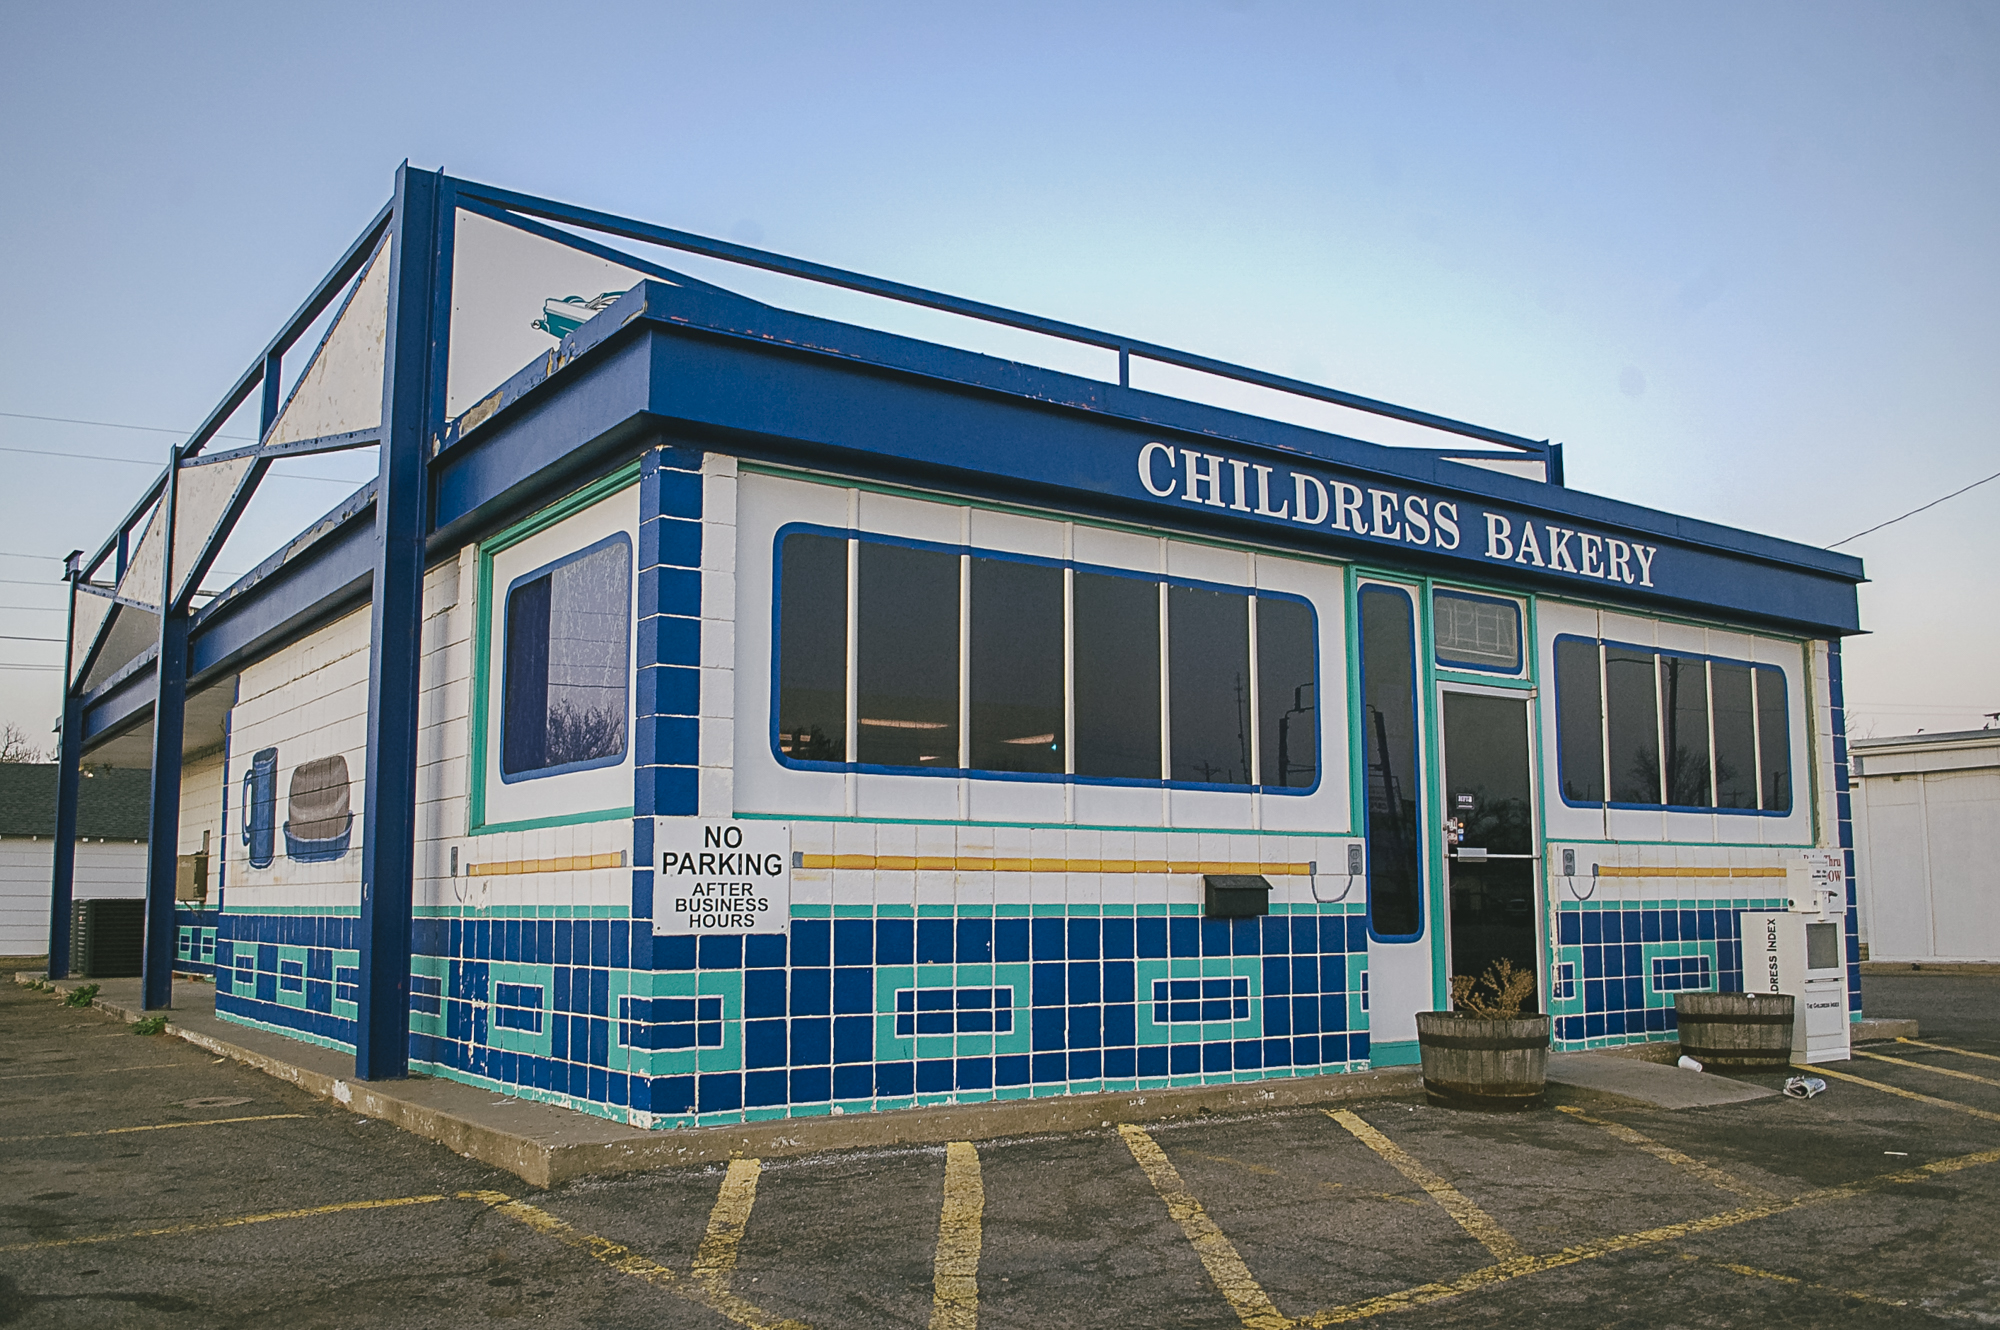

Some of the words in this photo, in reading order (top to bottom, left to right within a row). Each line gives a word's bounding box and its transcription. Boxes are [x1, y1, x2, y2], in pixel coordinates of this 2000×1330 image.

[1138, 442, 1460, 550] CHILDRESS
[1483, 512, 1657, 588] BAKERY
[704, 825, 743, 848] NO
[662, 852, 782, 877] PARKING
[692, 882, 754, 897] AFTER
[675, 898, 769, 913] BUSINESS
[689, 913, 755, 928] HOURS
[1766, 918, 1777, 952] INDEX
[1768, 955, 1780, 995] DRESS
